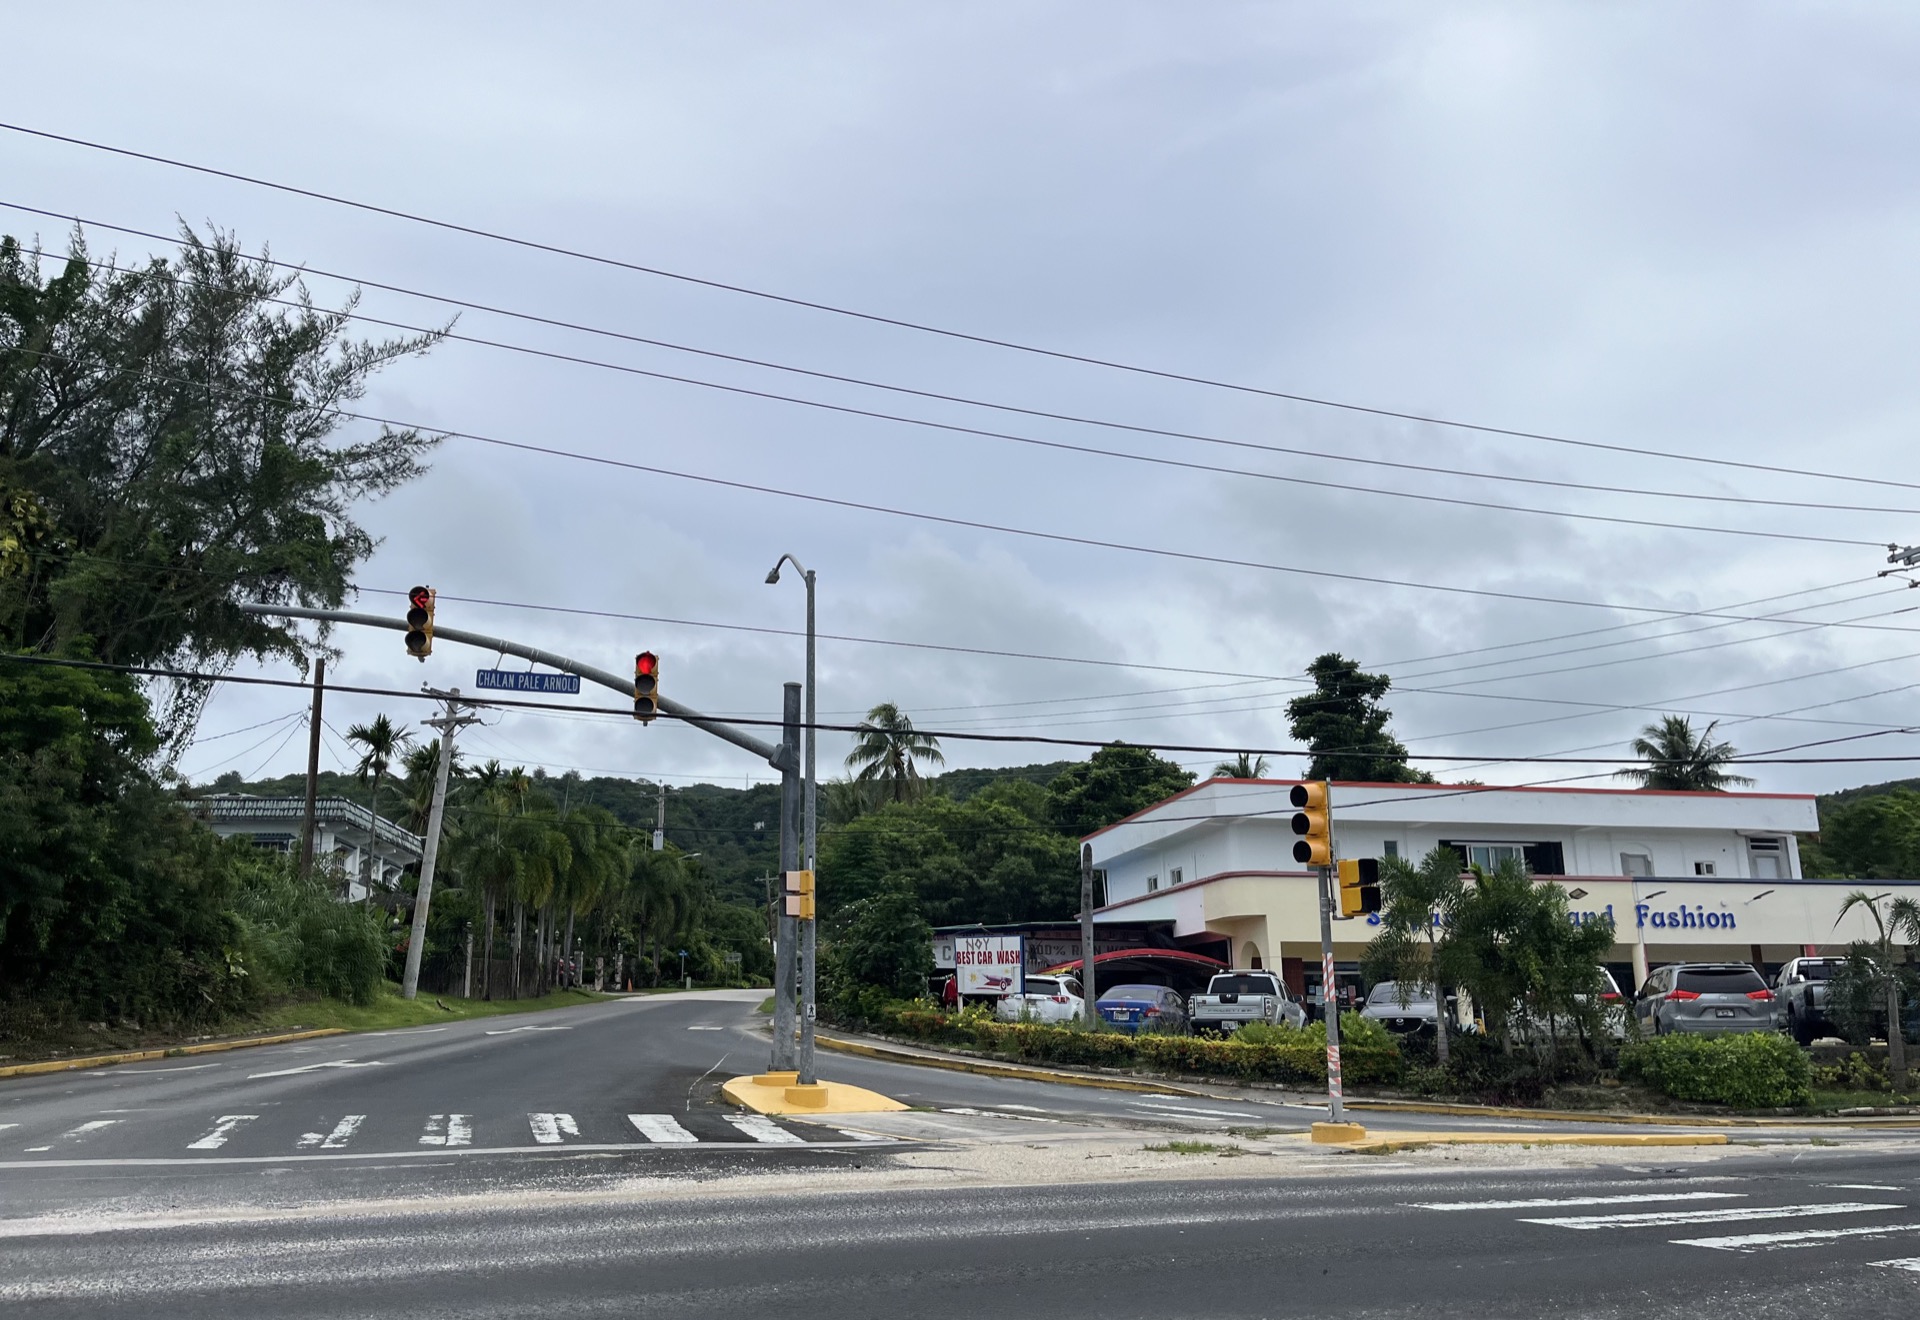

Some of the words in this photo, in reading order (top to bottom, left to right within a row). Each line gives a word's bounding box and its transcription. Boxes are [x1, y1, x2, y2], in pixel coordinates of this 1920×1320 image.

[478, 672, 514, 688] CHALAN
[518, 674, 540, 690] PALE
[543, 676, 578, 691] ARNOLD
[1635, 904, 1736, 928] Fashion
[956, 951, 975, 965] BEST
[977, 951, 993, 965] CAR
[996, 950, 1020, 965] WASH
